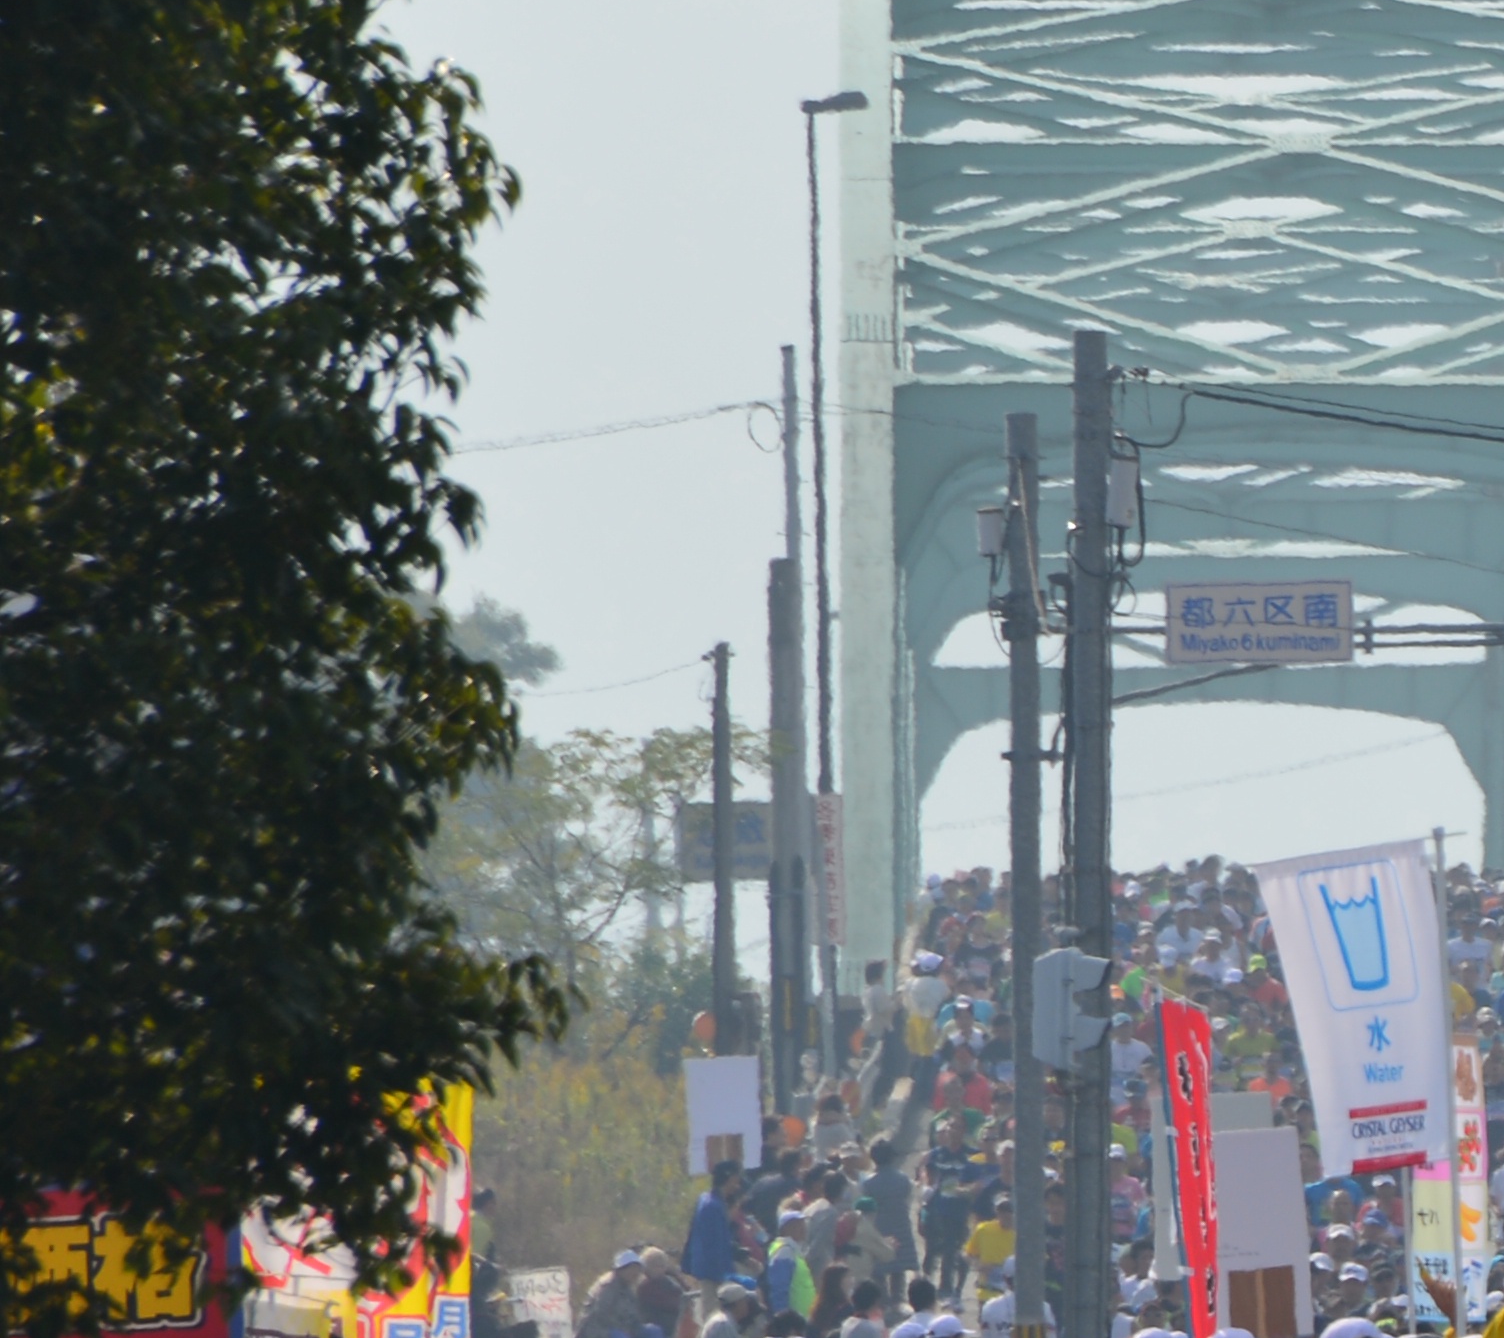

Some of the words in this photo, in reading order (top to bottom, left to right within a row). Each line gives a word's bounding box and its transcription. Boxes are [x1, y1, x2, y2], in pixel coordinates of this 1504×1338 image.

[1181, 593, 1339, 629] 都六区南
[1366, 1015, 1392, 1052] 水
[1363, 1063, 1404, 1084] Water
[1389, 1114, 1426, 1136] GEYSER
